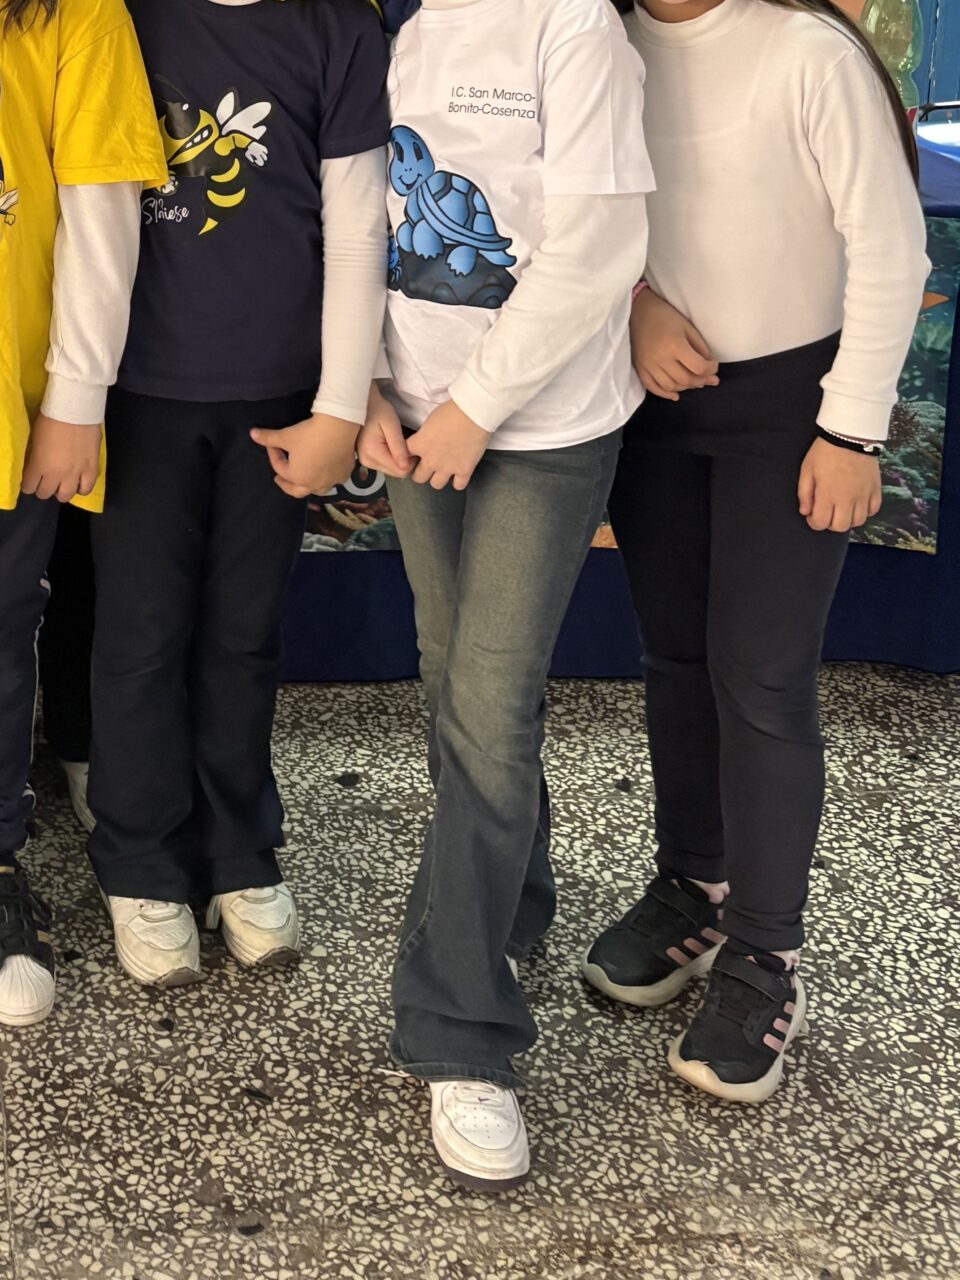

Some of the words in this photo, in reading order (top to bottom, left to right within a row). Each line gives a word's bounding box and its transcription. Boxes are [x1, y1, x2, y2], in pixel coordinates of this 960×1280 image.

[451, 85, 467, 98] I.C.
[468, 86, 489, 99] San
[492, 88, 536, 102] Marco-
[448, 101, 536, 119] Bonito-Cosenza
